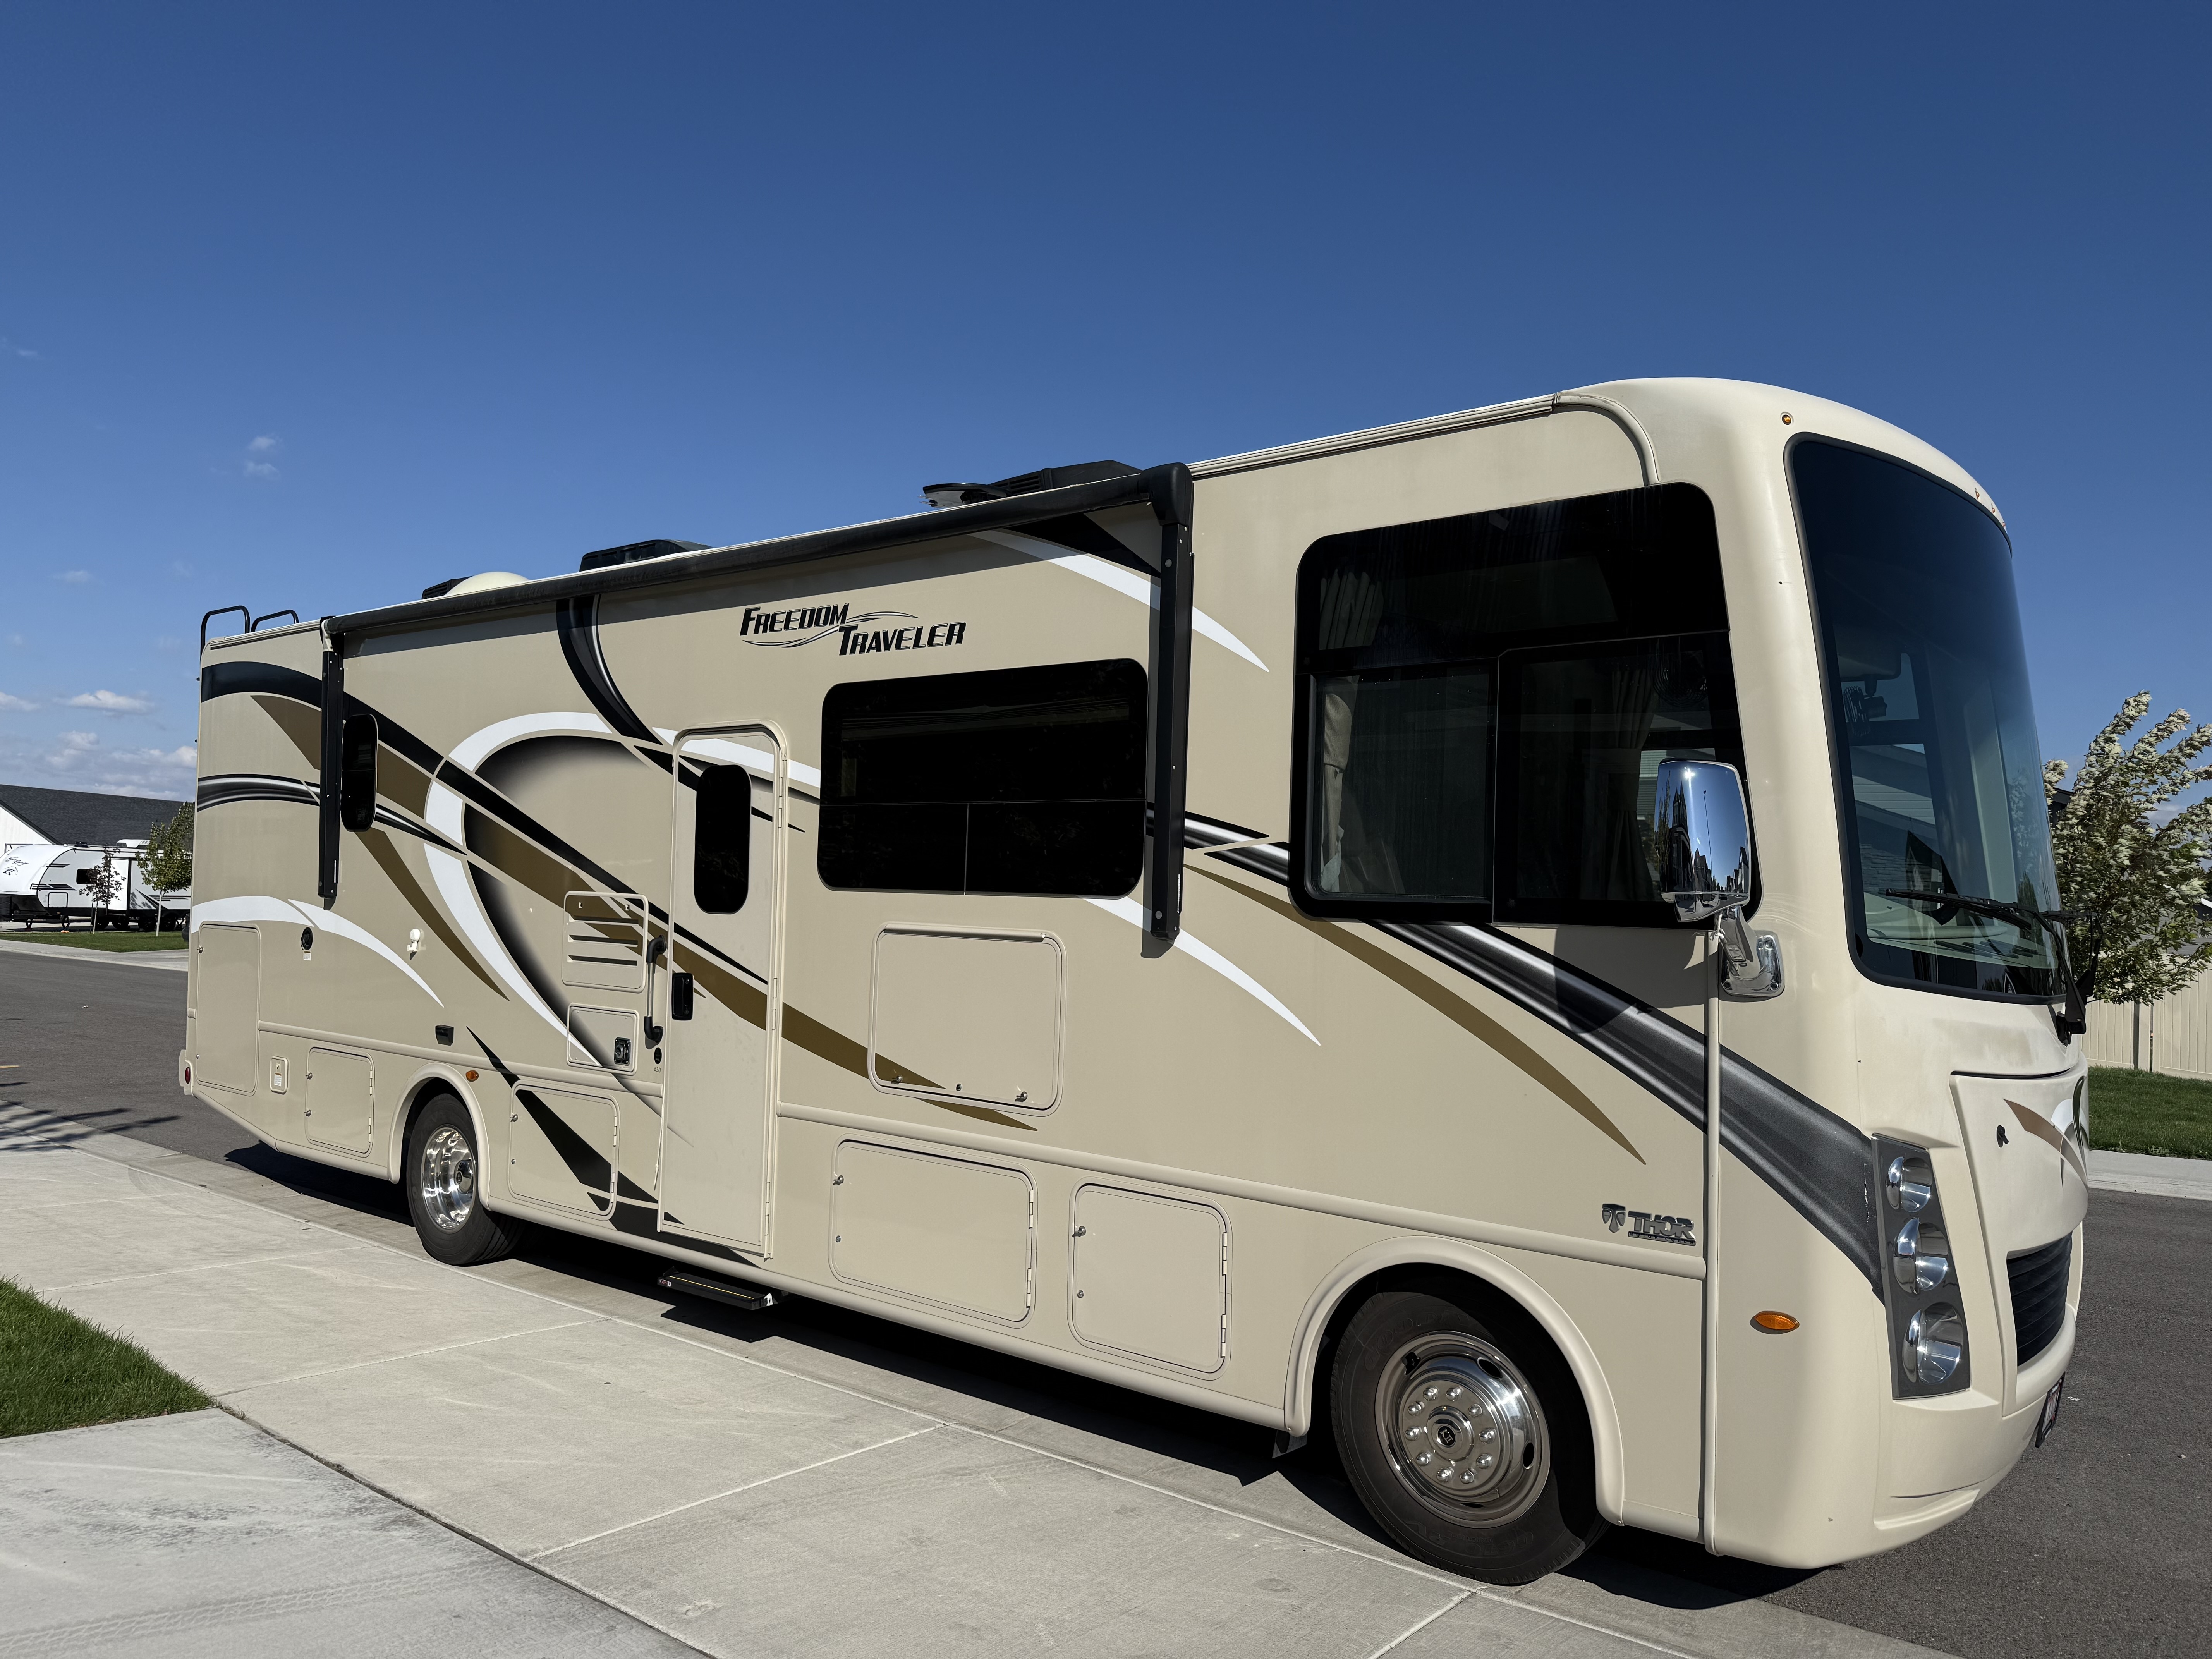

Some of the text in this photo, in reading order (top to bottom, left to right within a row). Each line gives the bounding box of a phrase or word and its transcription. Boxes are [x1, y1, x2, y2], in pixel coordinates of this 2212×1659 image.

[740, 603, 849, 636] FREEDOM
[838, 622, 966, 656] TRAVELER
[1628, 1211, 1696, 1240] THOR
